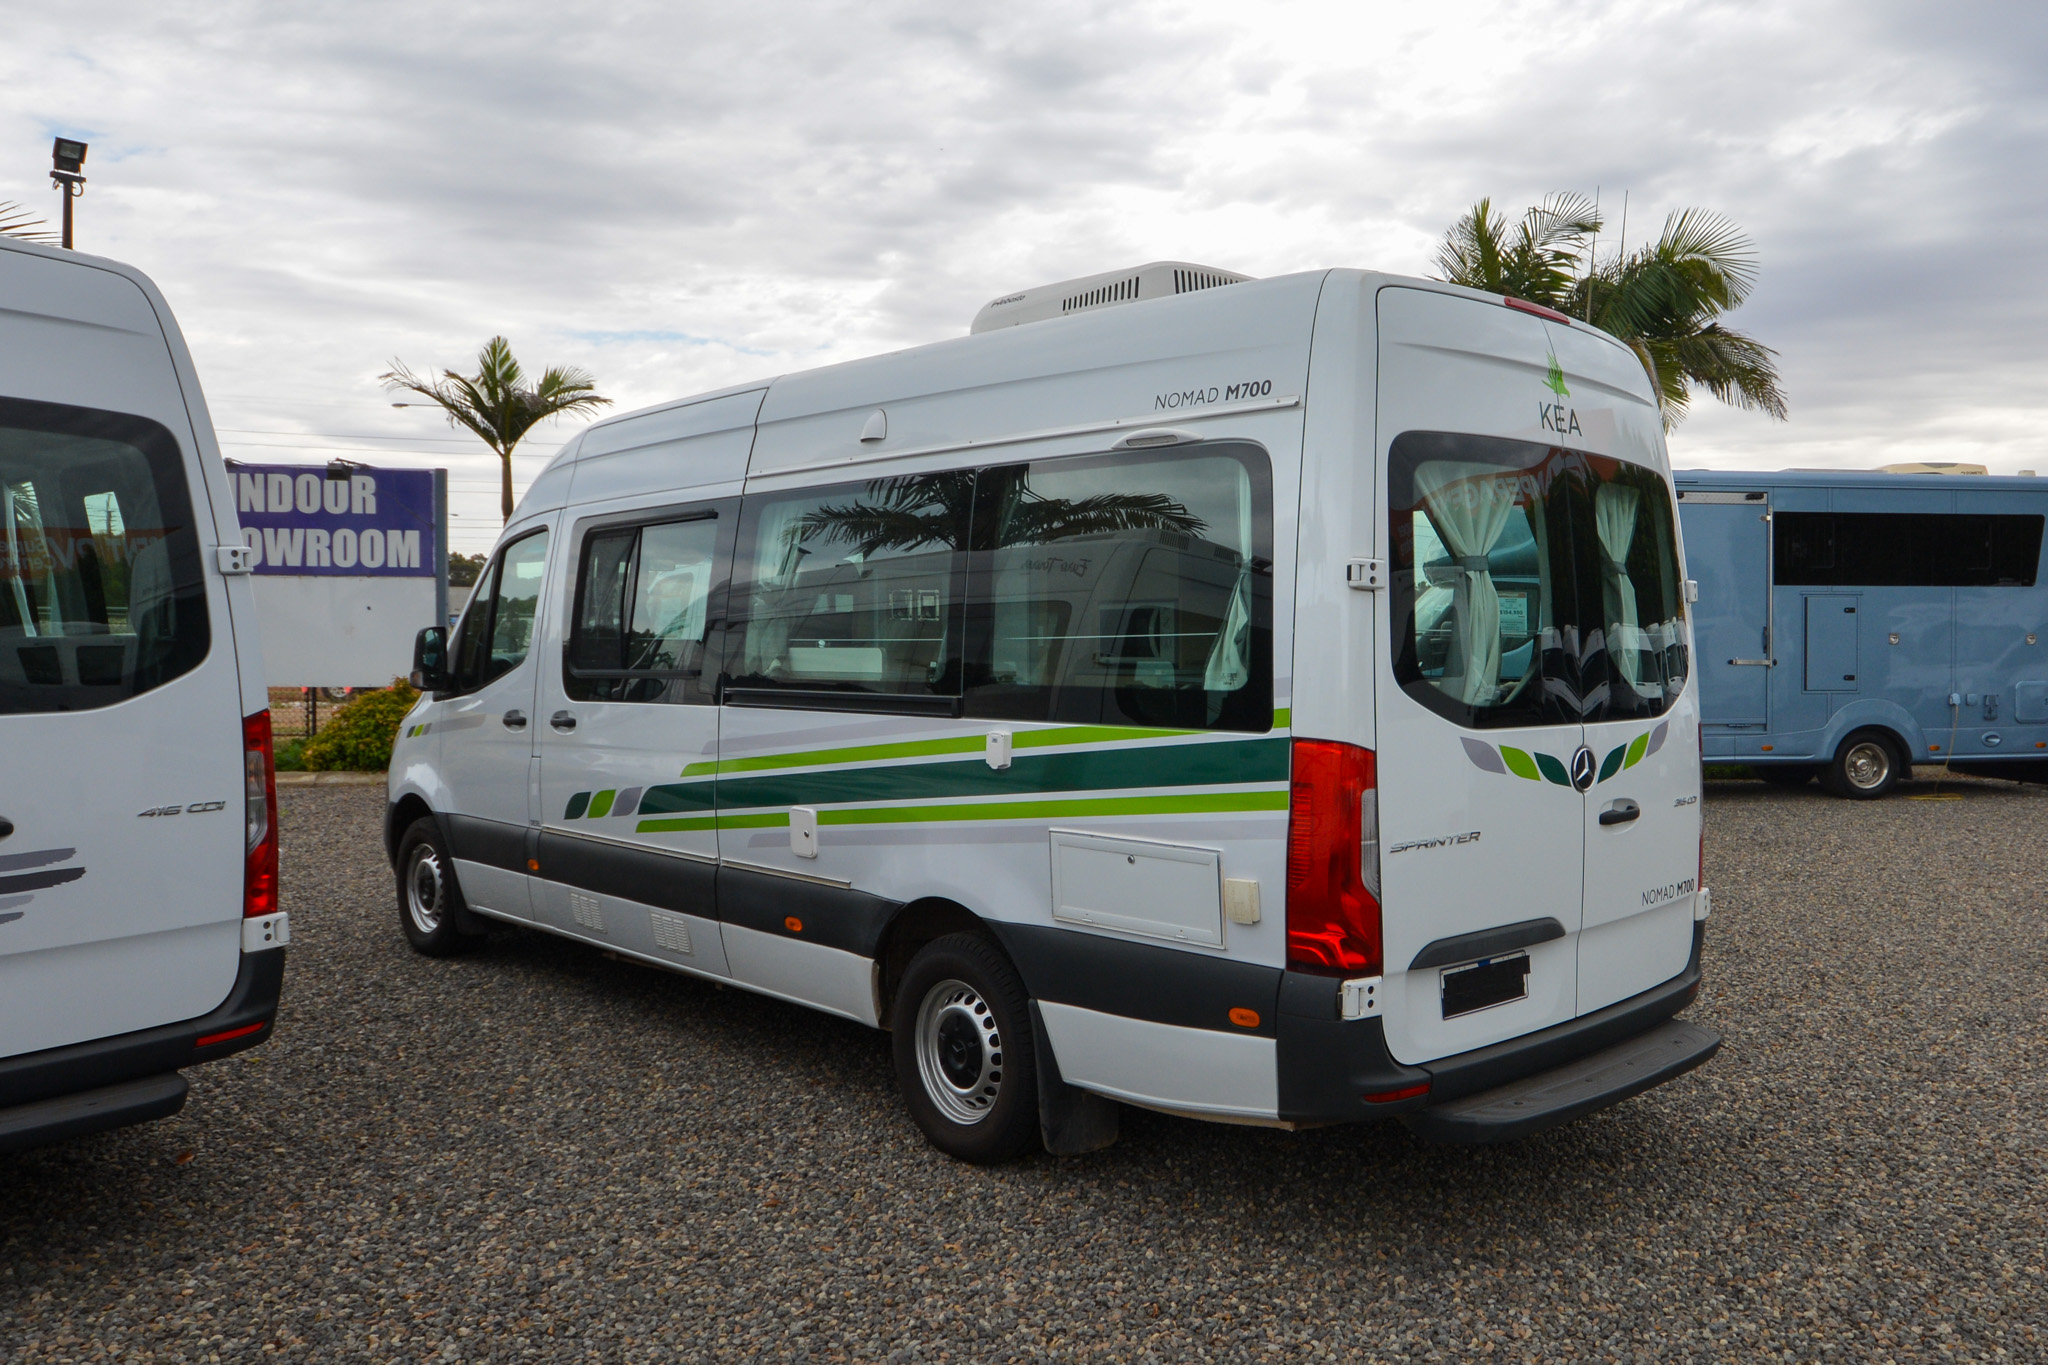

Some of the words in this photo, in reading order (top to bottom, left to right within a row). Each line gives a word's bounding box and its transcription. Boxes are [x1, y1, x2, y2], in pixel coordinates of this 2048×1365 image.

[1155, 387, 1219, 410] NOMAD
[1225, 379, 1272, 401] M700
[1539, 401, 1583, 437] KEA
[239, 526, 421, 569] OWROOM
[137, 805, 182, 817] 416
[186, 801, 226, 813] CDI
[1390, 831, 1481, 853] SPRINTER
[1641, 884, 1675, 906] NOMAD
[1677, 878, 1695, 896] M700
